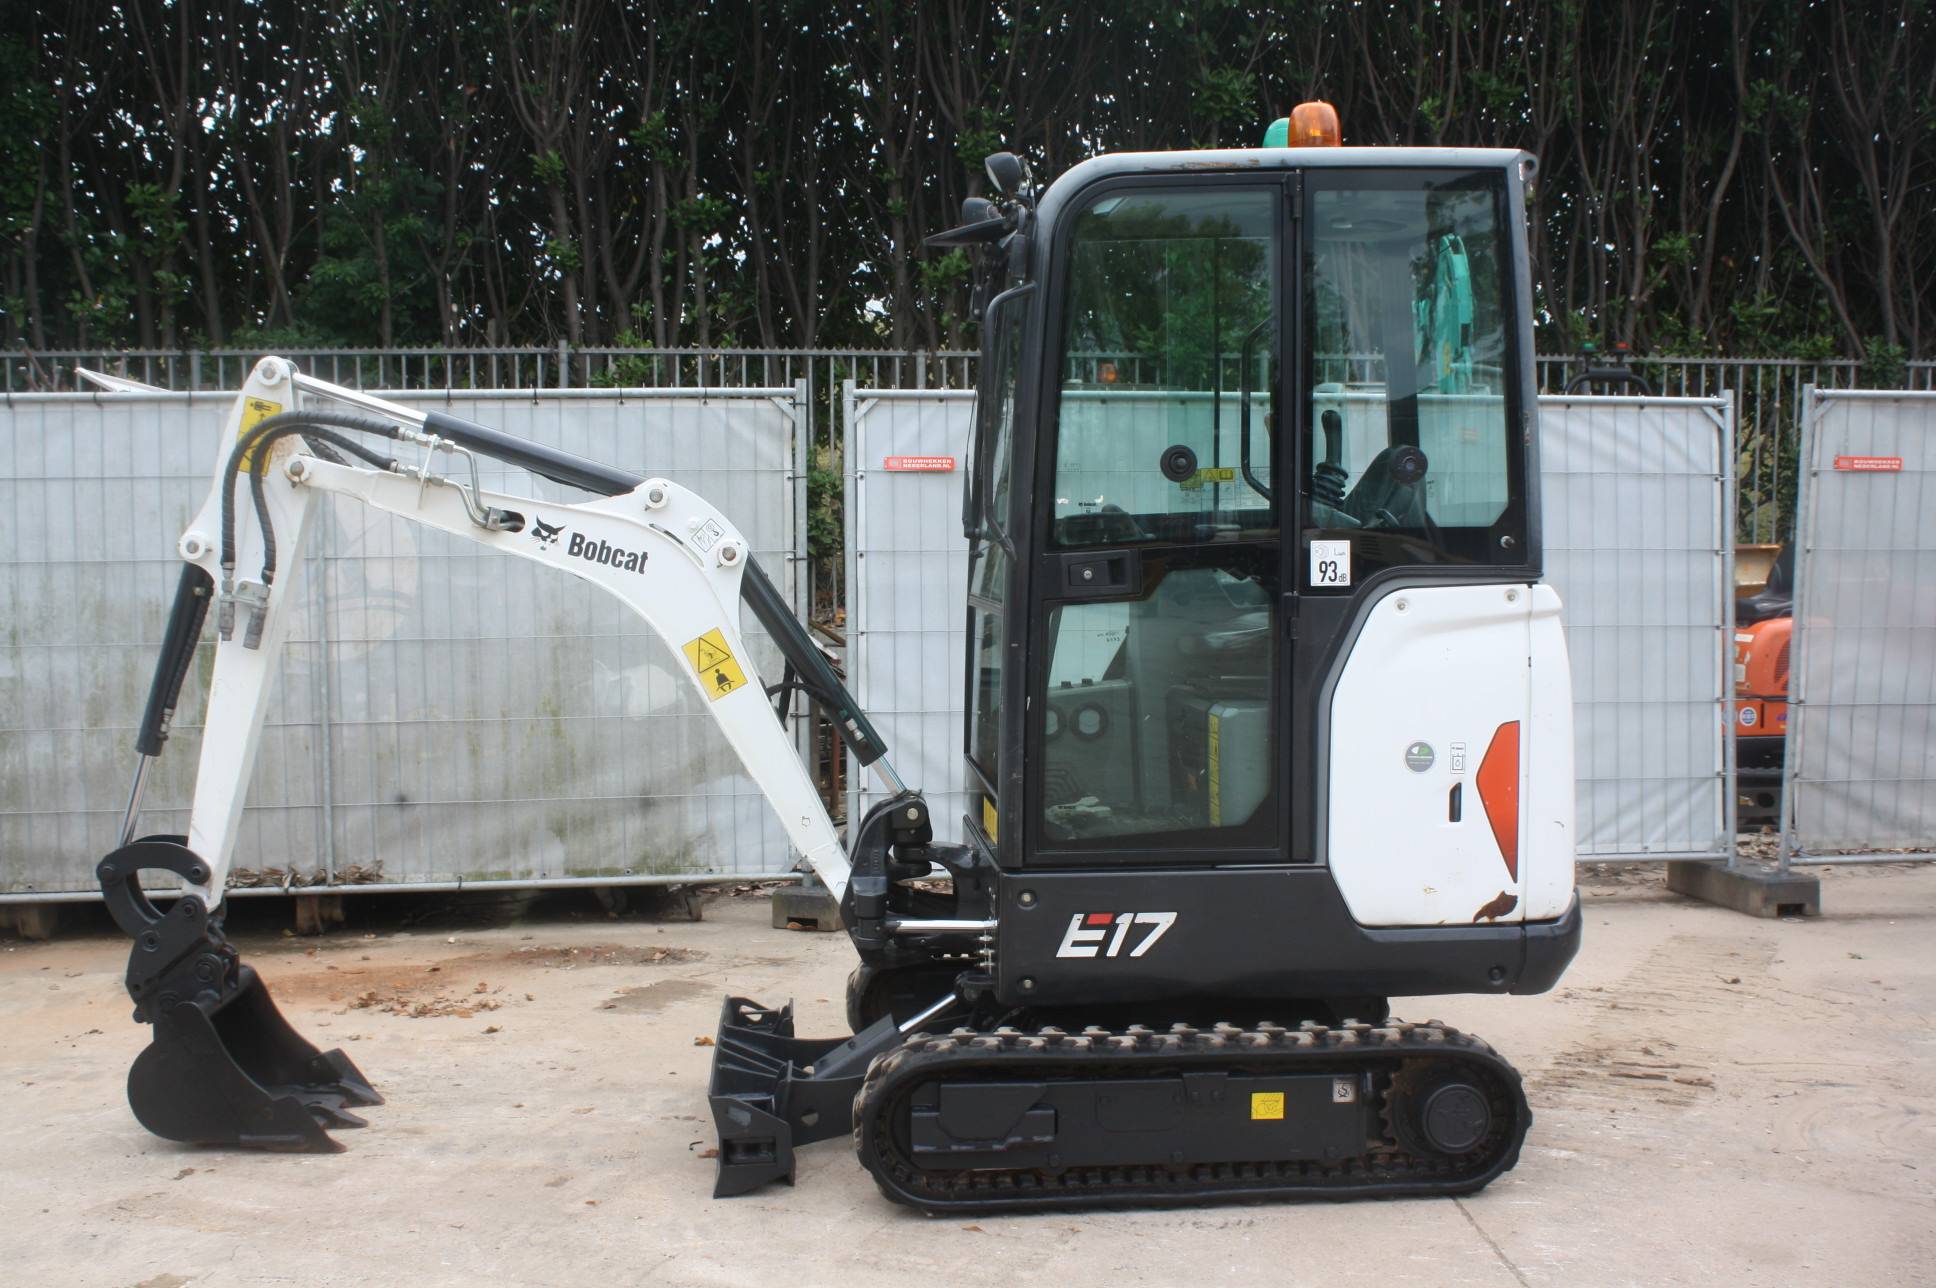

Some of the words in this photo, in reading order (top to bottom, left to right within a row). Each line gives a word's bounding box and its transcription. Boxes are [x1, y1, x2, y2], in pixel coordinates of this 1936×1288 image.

[568, 532, 649, 575] Bobcat
[1318, 560, 1338, 583] 93
[1338, 572, 1347, 583] dB
[1055, 911, 1178, 958] E17
